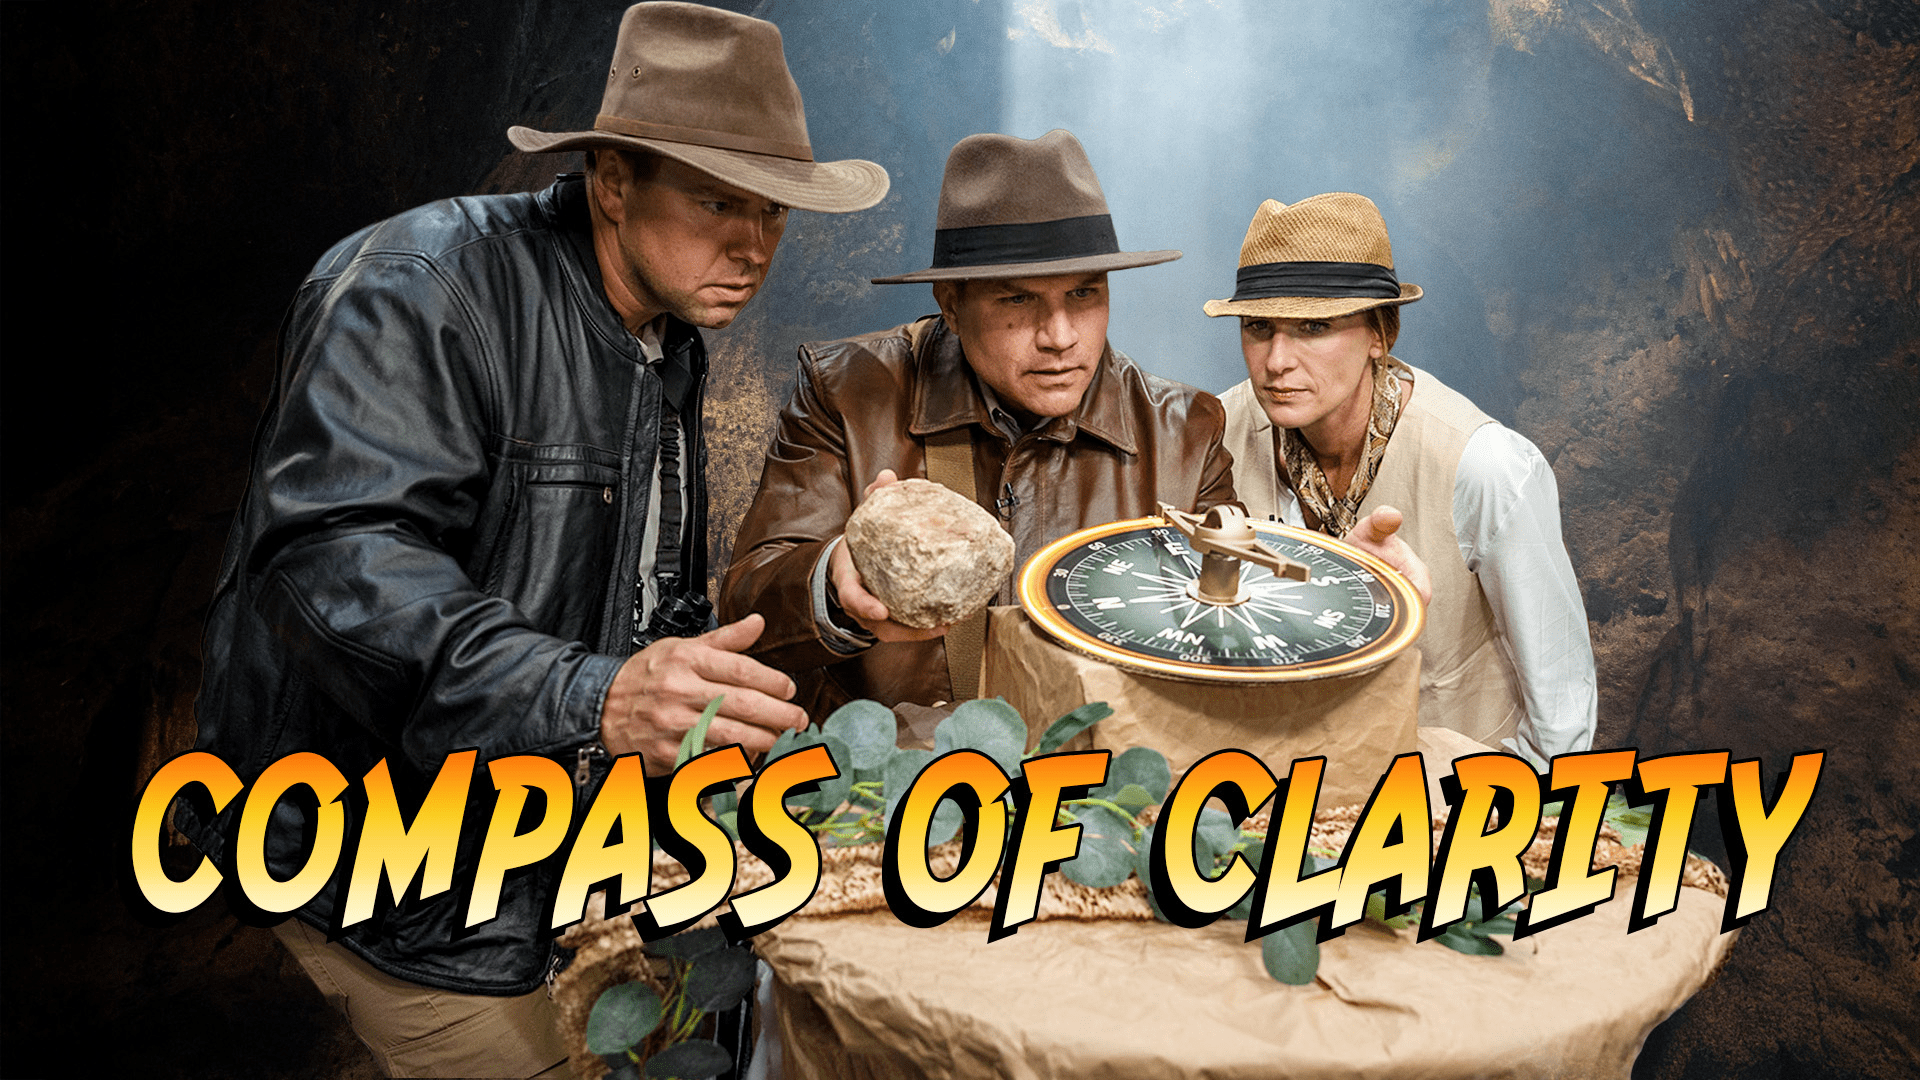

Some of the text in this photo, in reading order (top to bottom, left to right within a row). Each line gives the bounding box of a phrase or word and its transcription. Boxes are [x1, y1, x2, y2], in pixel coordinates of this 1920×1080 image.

[1151, 529, 1170, 537] 90
[1088, 541, 1107, 551] 60
[1164, 541, 1190, 556] E
[1297, 543, 1325, 555] 150
[1053, 568, 1069, 579] 30
[1103, 558, 1135, 576] NE
[1310, 576, 1340, 588] S
[1092, 596, 1127, 610] N
[1374, 603, 1391, 618] 210
[1313, 608, 1346, 630] SW
[1097, 631, 1129, 646] 330
[1156, 627, 1206, 646] NW
[1252, 634, 1288, 650] W
[1179, 653, 1212, 664] 300
[1272, 654, 1304, 666] 270
